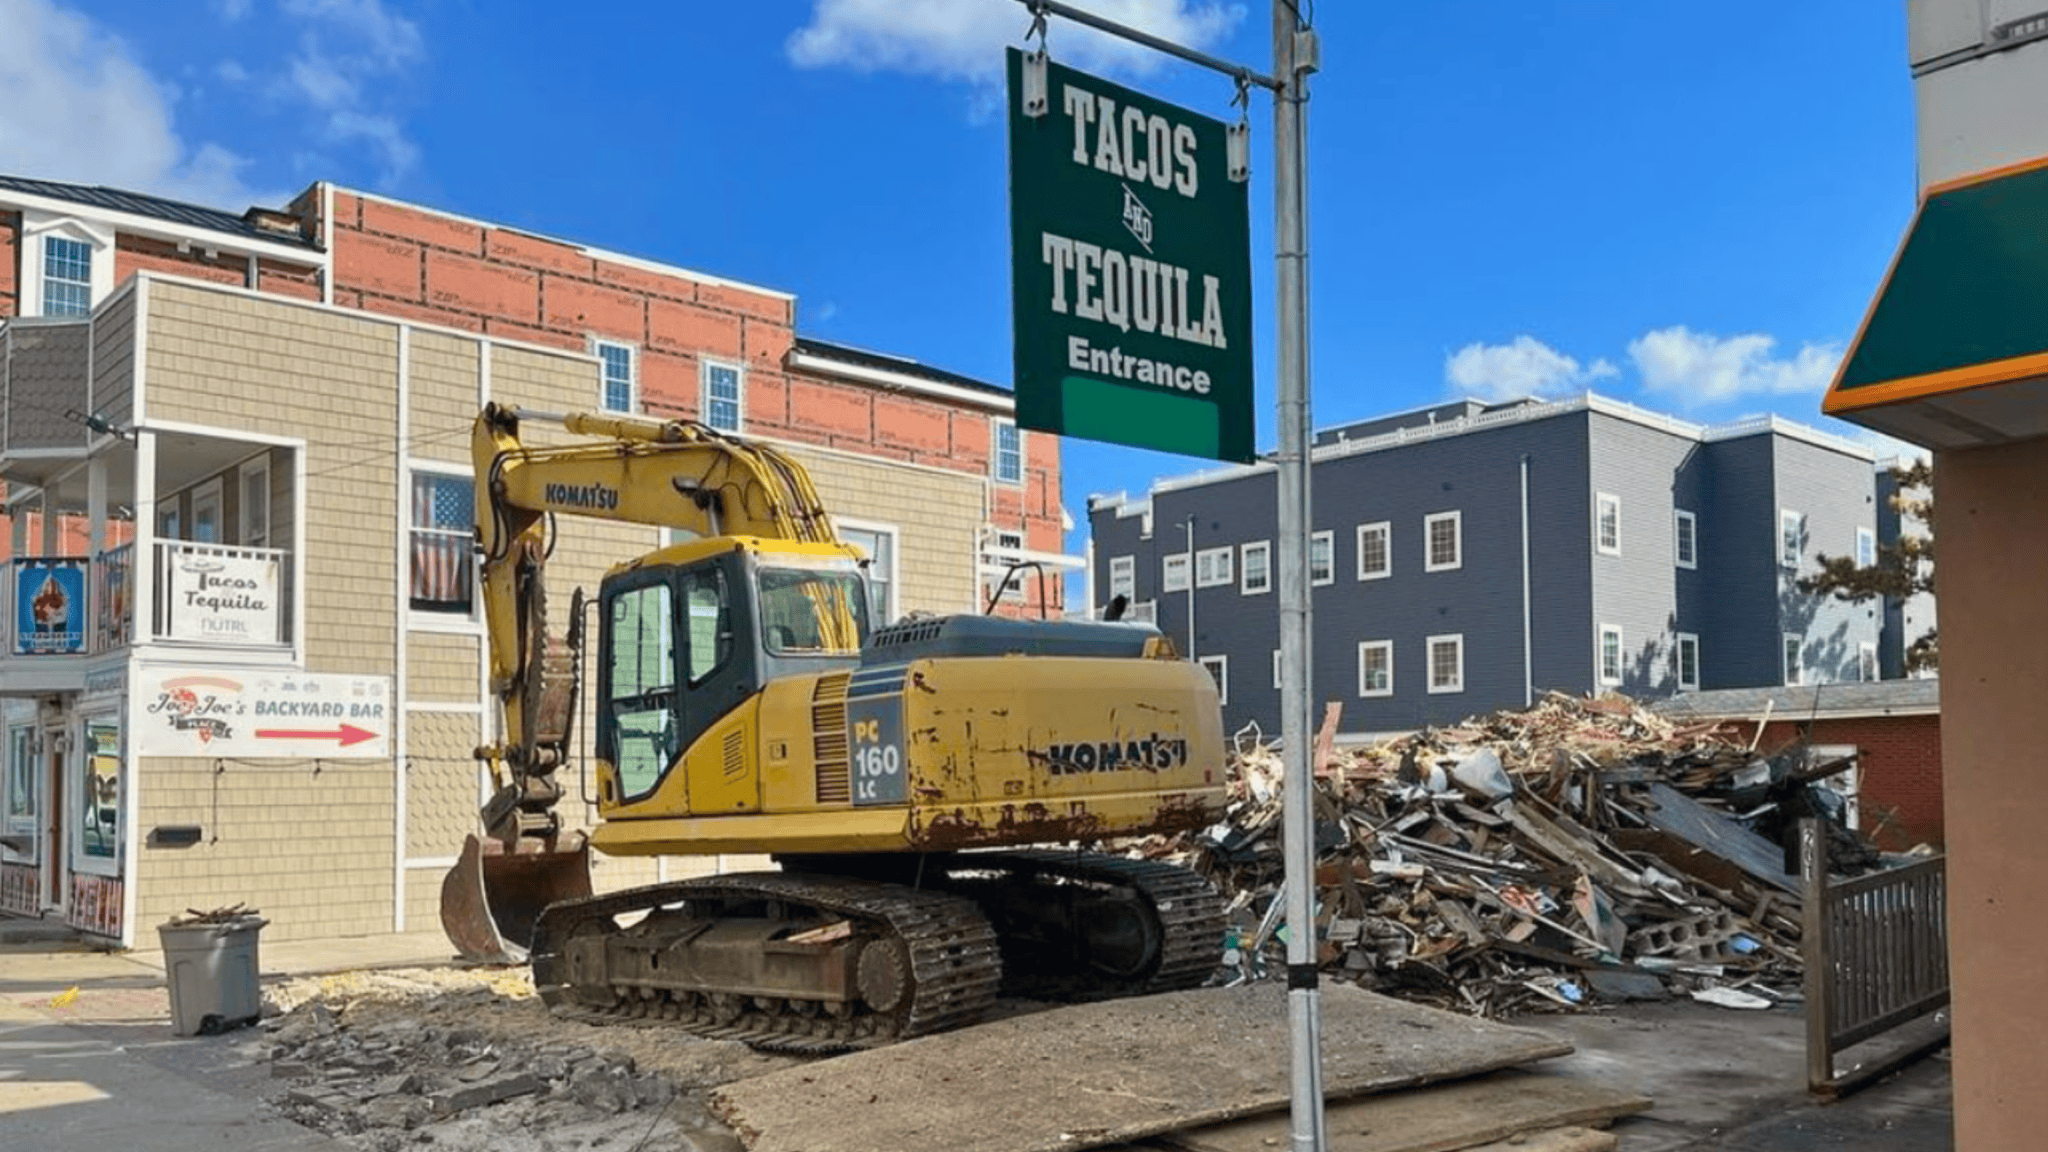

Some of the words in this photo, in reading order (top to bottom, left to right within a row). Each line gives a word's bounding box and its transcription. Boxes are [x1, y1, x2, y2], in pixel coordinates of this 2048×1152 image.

[1064, 85, 1198, 198] TACOS
[1042, 232, 1226, 349] TEQUILA
[1068, 335, 1211, 394] Entrance
[545, 482, 618, 510] KOMATSU
[188, 567, 258, 590] Tacos
[184, 591, 269, 613] Tequila
[255, 700, 344, 718] BACKYARD
[350, 703, 384, 719] BAR
[854, 719, 879, 743] PC
[855, 744, 900, 777] 160
[858, 780, 877, 799] LC
